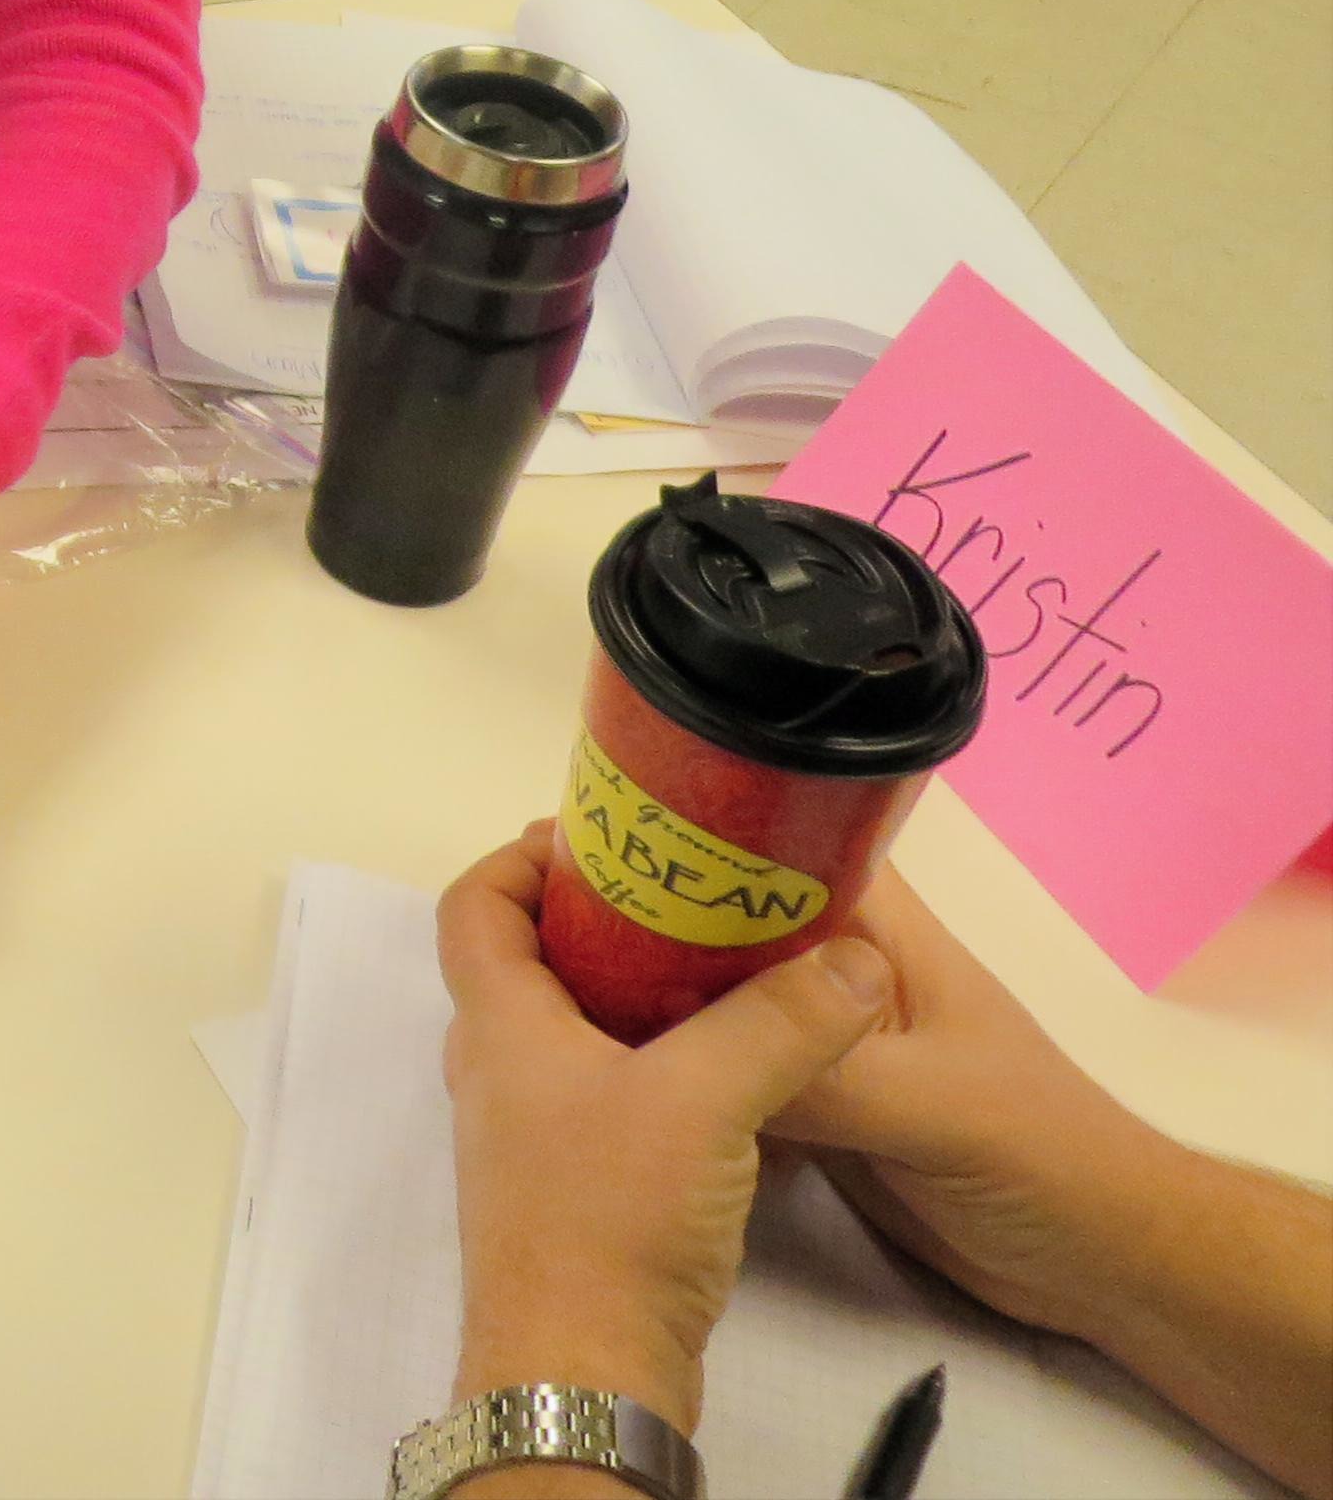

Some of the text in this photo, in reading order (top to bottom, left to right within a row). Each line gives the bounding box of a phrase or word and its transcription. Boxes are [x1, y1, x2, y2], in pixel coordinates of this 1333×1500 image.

[871, 428, 1165, 759] Kristin
[636, 802, 782, 877] Ground
[583, 851, 663, 919] Coffee
